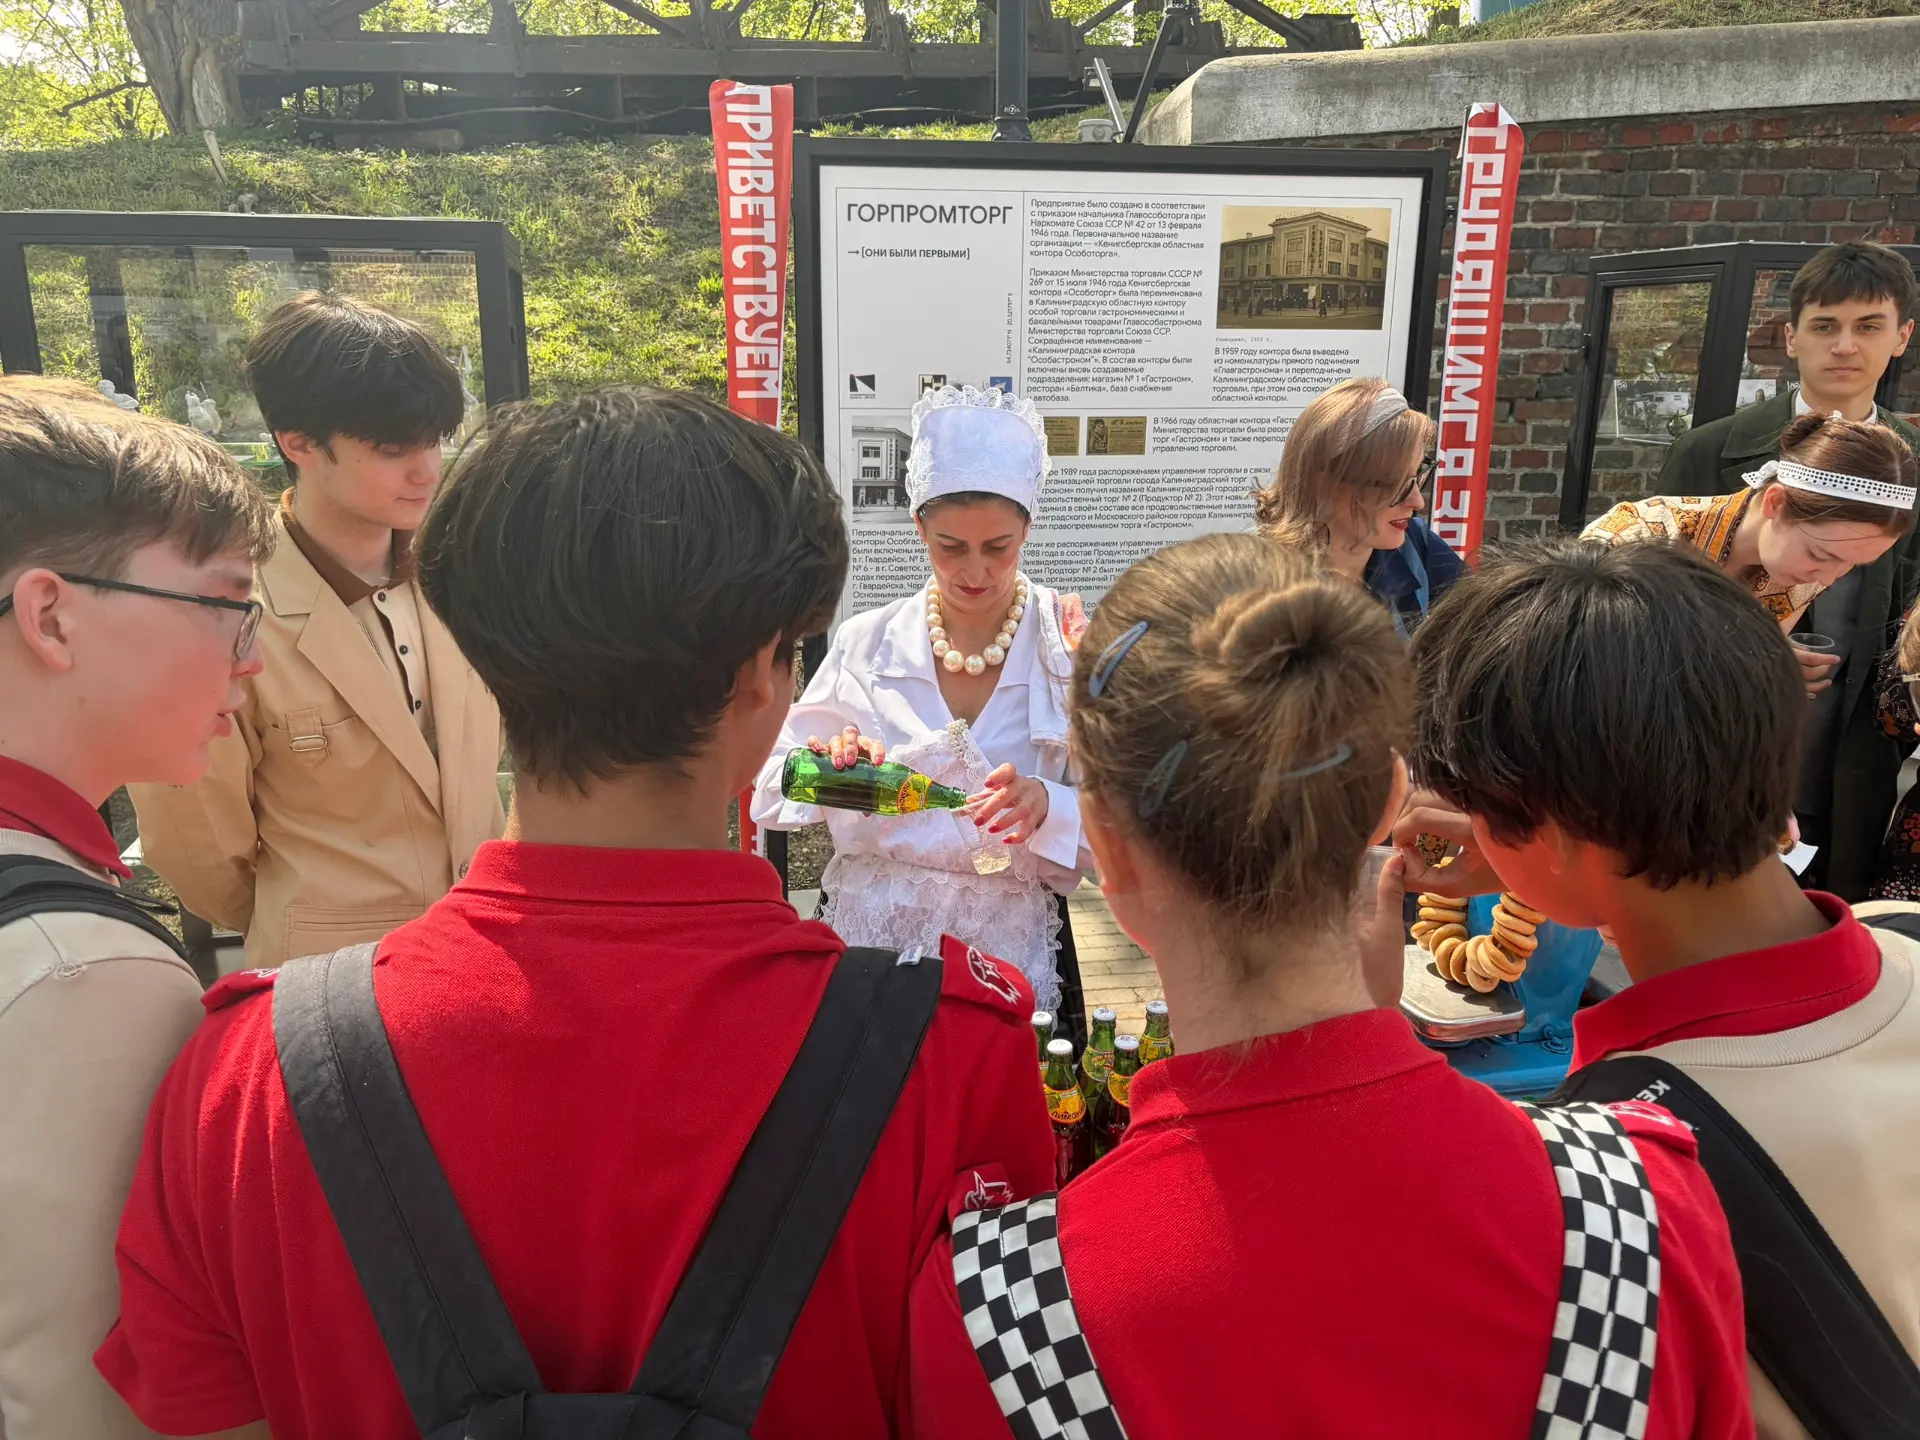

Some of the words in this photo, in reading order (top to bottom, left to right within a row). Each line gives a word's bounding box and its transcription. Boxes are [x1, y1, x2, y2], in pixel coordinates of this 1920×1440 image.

[1031, 199, 1085, 209] Предприятие
[1087, 200, 1108, 208] было
[1110, 202, 1143, 210] создано
[847, 203, 1013, 225] ГОРПРОМТОРГ
[1037, 211, 1076, 219] приказом
[1031, 219, 1075, 229] Наркомате
[1076, 220, 1103, 228] Союза
[1104, 220, 1122, 228] ССР
[1167, 221, 1201, 231] февраля
[1072, 229, 1140, 240] Первоначальное
[724, 85, 780, 399] ПРИВЕТСТВУЕМ
[1030, 241, 1082, 249] организации
[1162, 241, 1204, 249] областная
[889, 248, 917, 259] БЫЛИ
[1030, 268, 1069, 278] Приказом
[1071, 269, 1128, 279] Министерства
[1168, 270, 1191, 278] СССР
[1029, 278, 1043, 286] 269
[1128, 279, 1190, 289] Кенигсбергская
[1029, 290, 1062, 298] контора
[1140, 291, 1202, 299] переименована
[1035, 298, 1107, 308] Калининградскую
[1108, 298, 1152, 308] областную
[1153, 300, 1186, 308] контору
[1028, 317, 1082, 325] бакалейными
[1028, 327, 1086, 336] Министерства
[1087, 329, 1124, 337] торговли
[1102, 348, 1135, 356] контора
[1222, 347, 1239, 355] 1959
[1240, 349, 1258, 357] году
[1259, 349, 1290, 357] контора
[1213, 375, 1286, 384] Калининградскому
[1287, 375, 1333, 384] областному
[1027, 386, 1064, 394] ресторан
[1110, 384, 1128, 392] база
[1129, 384, 1172, 392] снабжения
[1213, 386, 1249, 394] торговли,
[1251, 386, 1265, 394] при
[1179, 418, 1196, 426] году
[1197, 416, 1238, 424] областная
[1153, 426, 1208, 435] Министерства
[1210, 427, 1245, 435] торговли
[1246, 425, 1266, 433] была
[1061, 468, 1078, 476] 1989
[1098, 469, 1160, 477] распоряжением
[1161, 468, 1206, 476] управления
[1207, 468, 1242, 476] торговли
[1096, 478, 1131, 486] торговли
[1132, 478, 1160, 486] города
[1161, 475, 1229, 485] Калининградский
[1230, 477, 1247, 485] торг
[1076, 487, 1108, 495] получил
[1146, 484, 1213, 494] Калининградский
[1103, 496, 1120, 504] торг
[1205, 493, 1224, 501] Этот
[1146, 504, 1222, 512] продовольственные
[1094, 512, 1144, 520] Московского
[1145, 512, 1178, 521] районов
[1179, 513, 1206, 521] города
[1048, 523, 1119, 531] правопреемником
